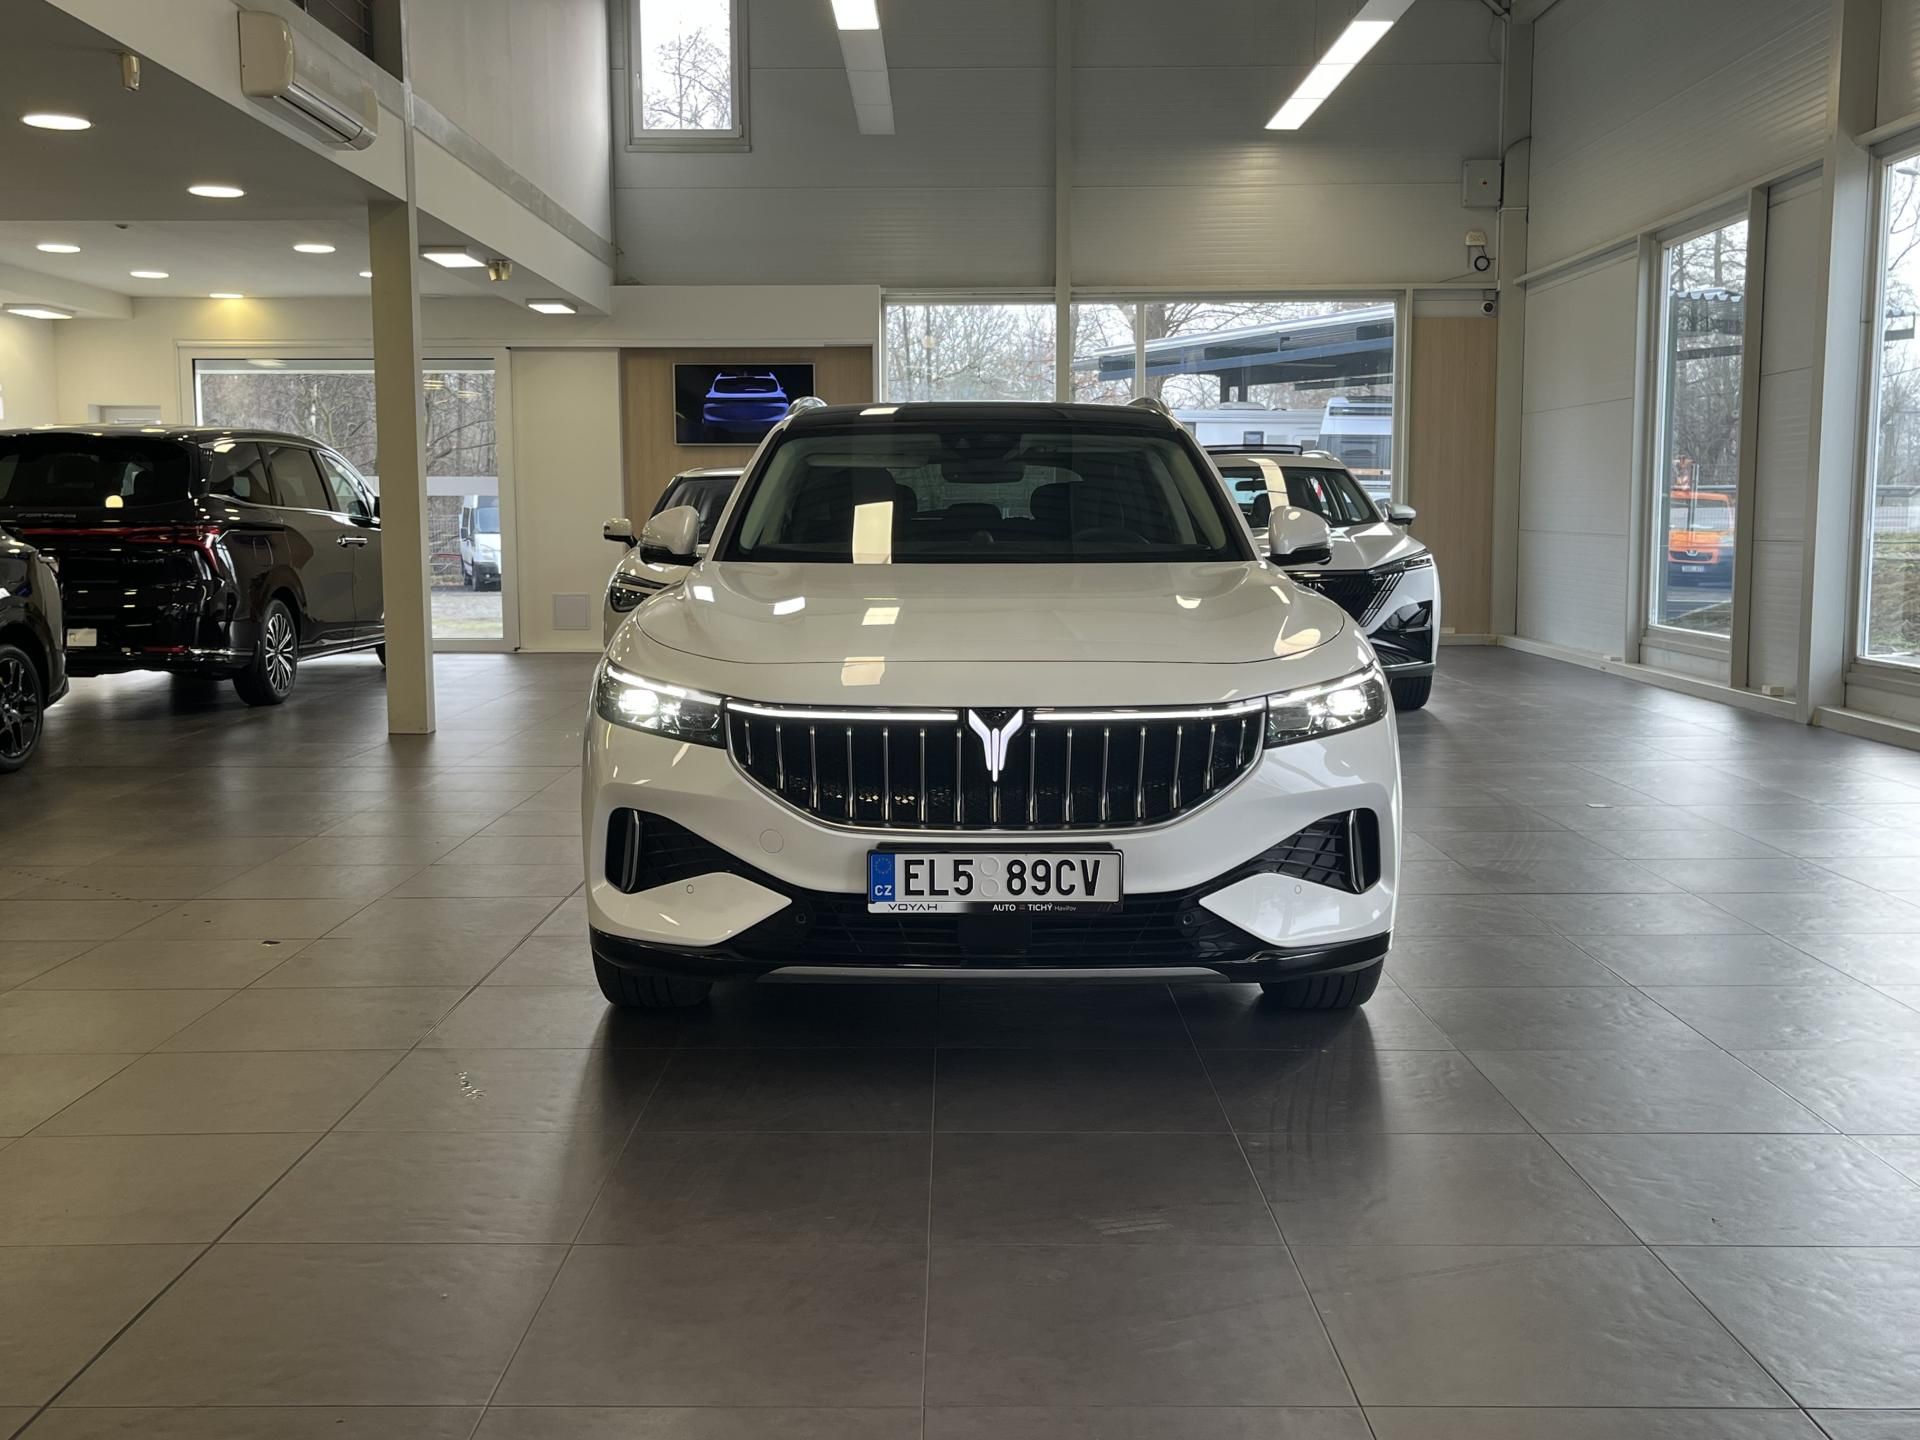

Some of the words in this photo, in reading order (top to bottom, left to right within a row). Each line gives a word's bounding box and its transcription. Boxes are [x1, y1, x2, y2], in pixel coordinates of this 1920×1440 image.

[904, 859, 974, 896] EL5
[1006, 859, 1101, 896] 89CV
[874, 885, 892, 896] CZ
[888, 903, 938, 911] VOYAH
[992, 904, 1016, 912] AUTO
[1027, 902, 1053, 912] TICHÝ
